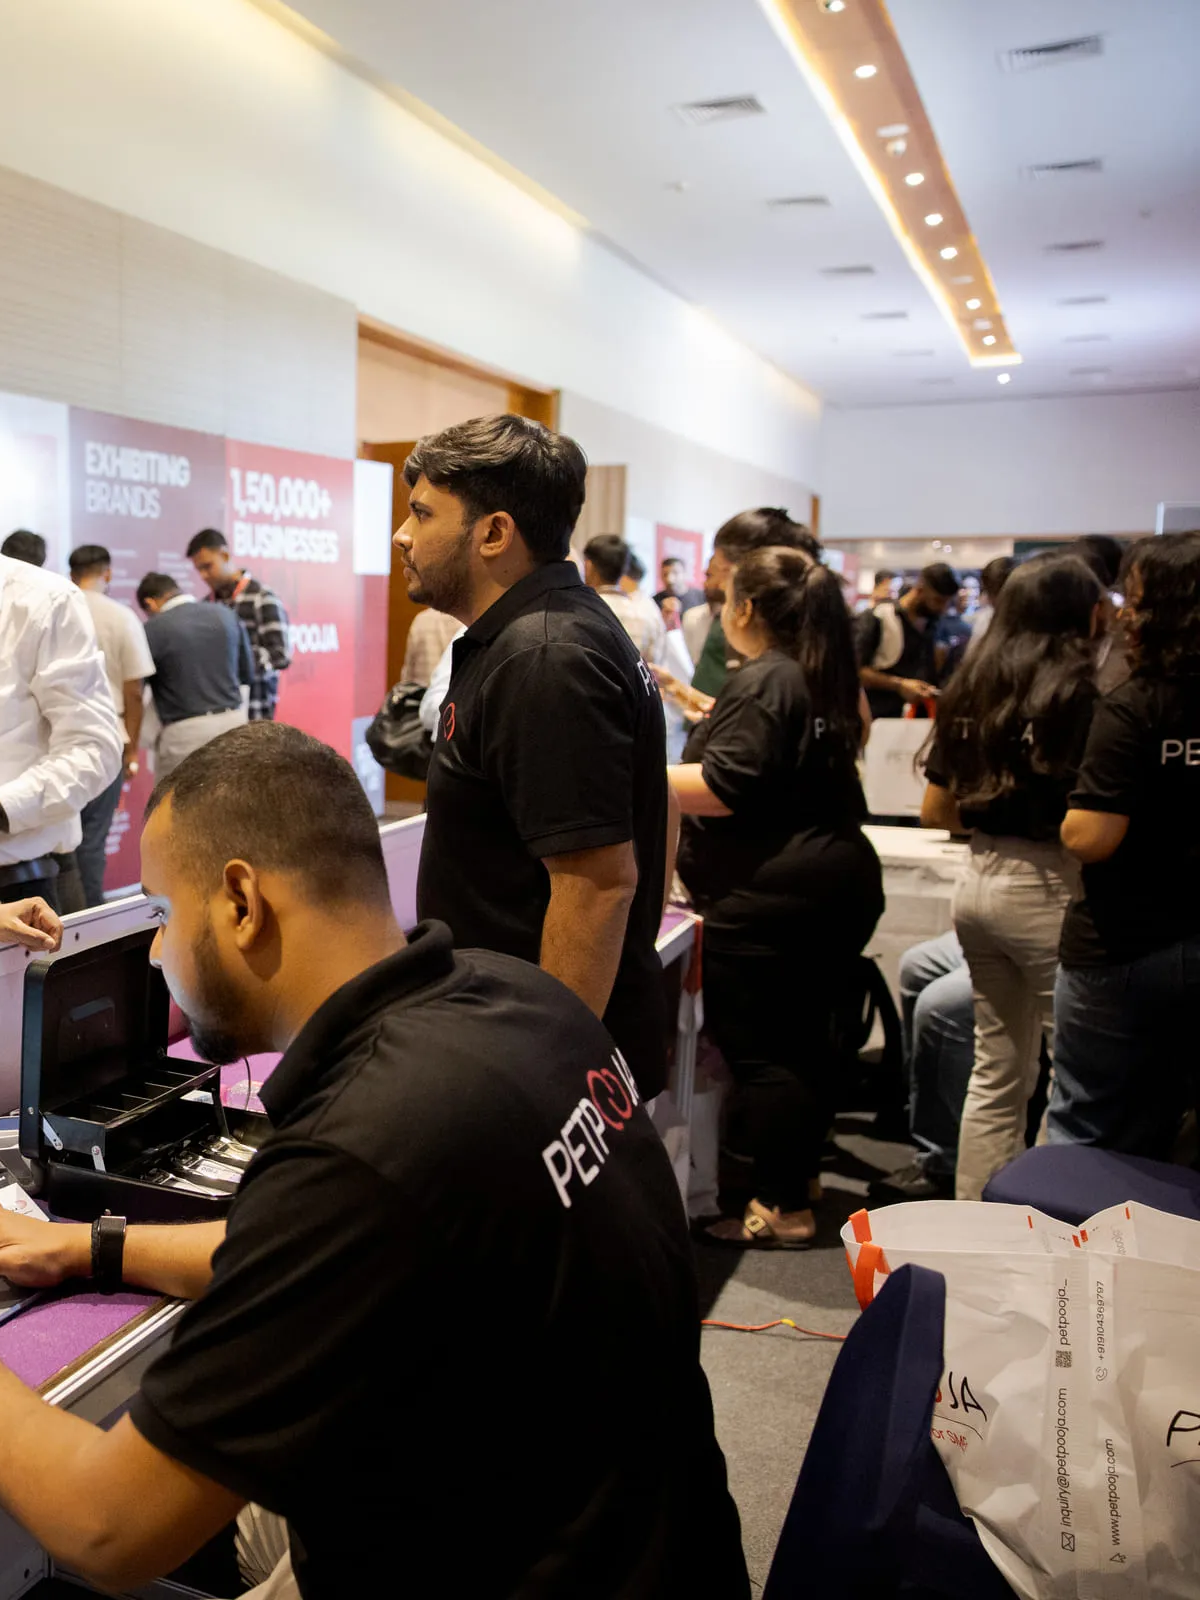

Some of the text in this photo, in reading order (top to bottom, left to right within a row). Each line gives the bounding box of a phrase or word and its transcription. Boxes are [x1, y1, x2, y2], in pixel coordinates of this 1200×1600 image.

[85, 441, 191, 488] EXHIBITING
[85, 479, 161, 519] BRANDS
[230, 467, 332, 522] 1,50,000+
[233, 521, 339, 564] BUSINESSES
[1054, 1388, 1073, 1528] inquiry@petpooja.com
[1105, 1438, 1121, 1546] www.petpooja.com
